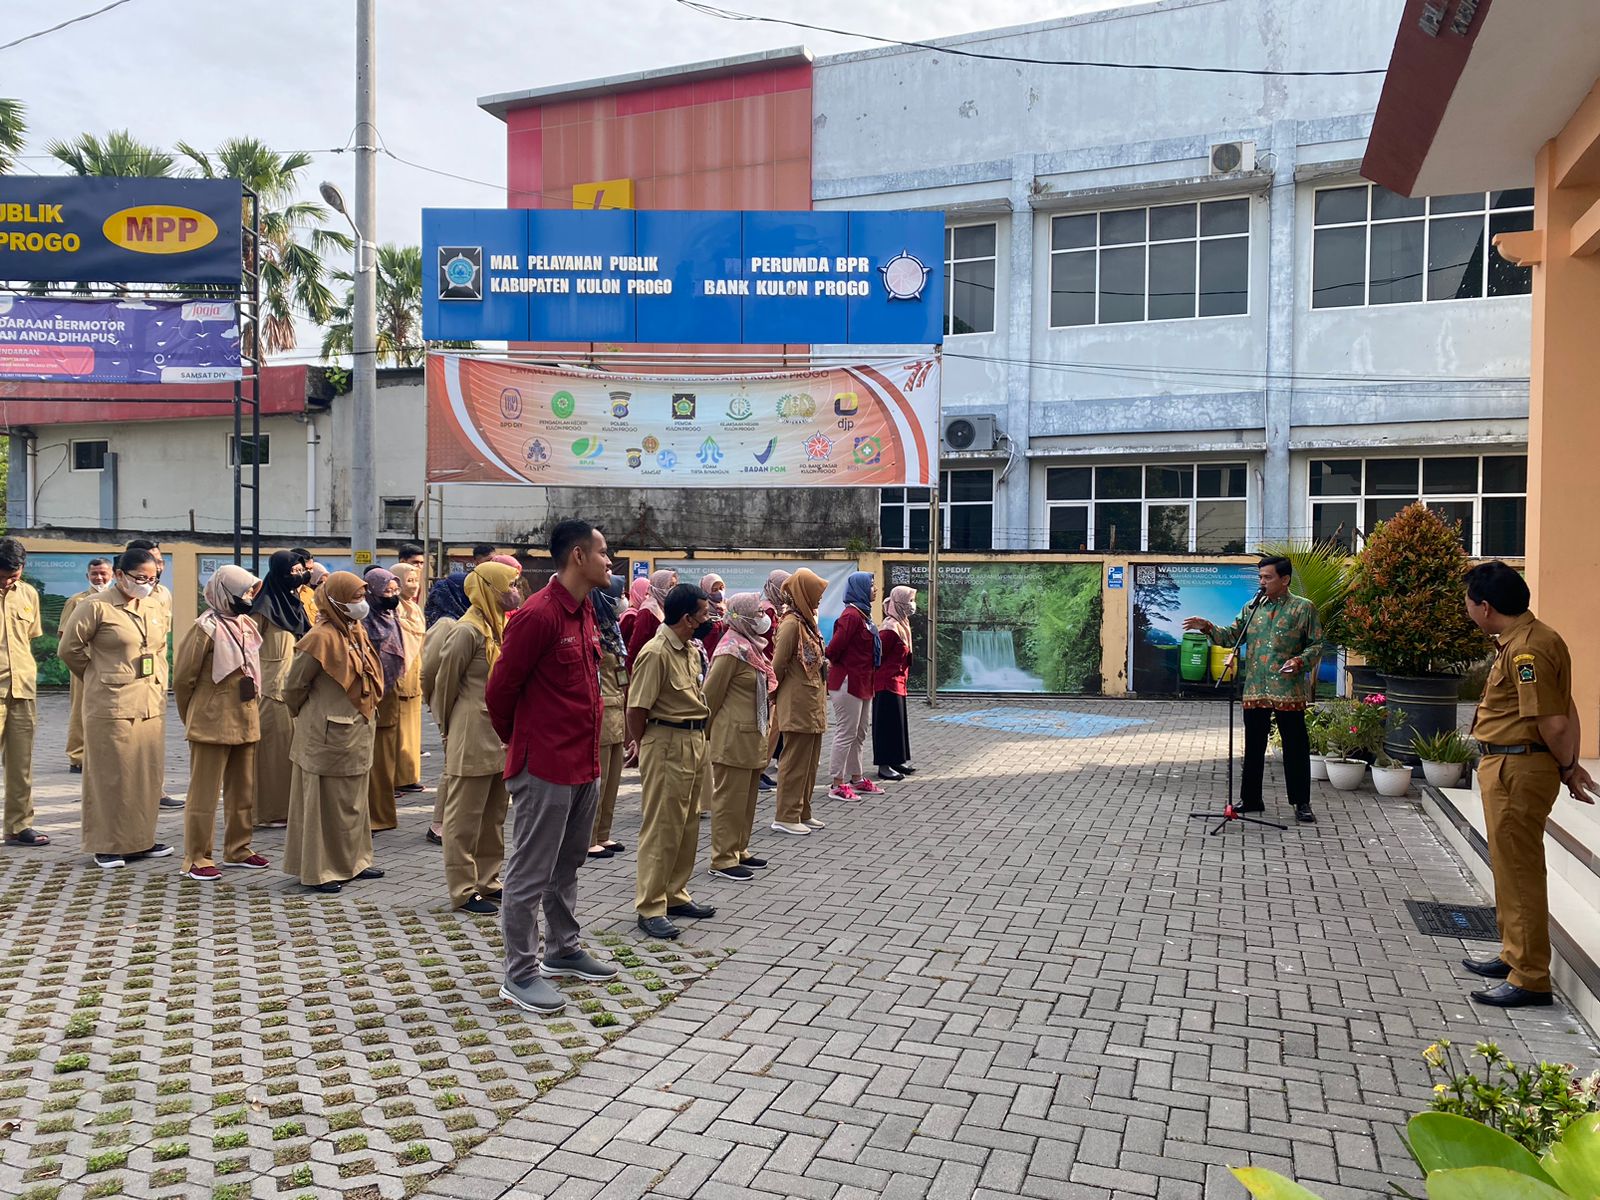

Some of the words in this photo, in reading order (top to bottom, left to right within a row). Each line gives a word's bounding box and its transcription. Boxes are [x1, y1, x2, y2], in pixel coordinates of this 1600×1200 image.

[126, 216, 199, 243] MPP
[0, 232, 80, 252] PROGO
[490, 255, 519, 271] MAL
[528, 255, 602, 271] PELAYANAN
[609, 256, 658, 272] PUBLIK
[751, 257, 830, 273] PERUMDA
[836, 257, 869, 273] BPR
[490, 278, 569, 293] KABUPATEN
[576, 278, 620, 294] KULON
[627, 279, 672, 294] PROGO
[703, 279, 749, 295] BANK
[756, 280, 808, 296] KULON
[814, 280, 869, 296] PROGO
[55, 320, 125, 331] BERMOTOR
[19, 331, 58, 342] ANDA
[58, 332, 116, 343] DIHAPUS
[837, 417, 854, 431] djp
[634, 562, 641, 571] P
[1108, 567, 1115, 575] P
